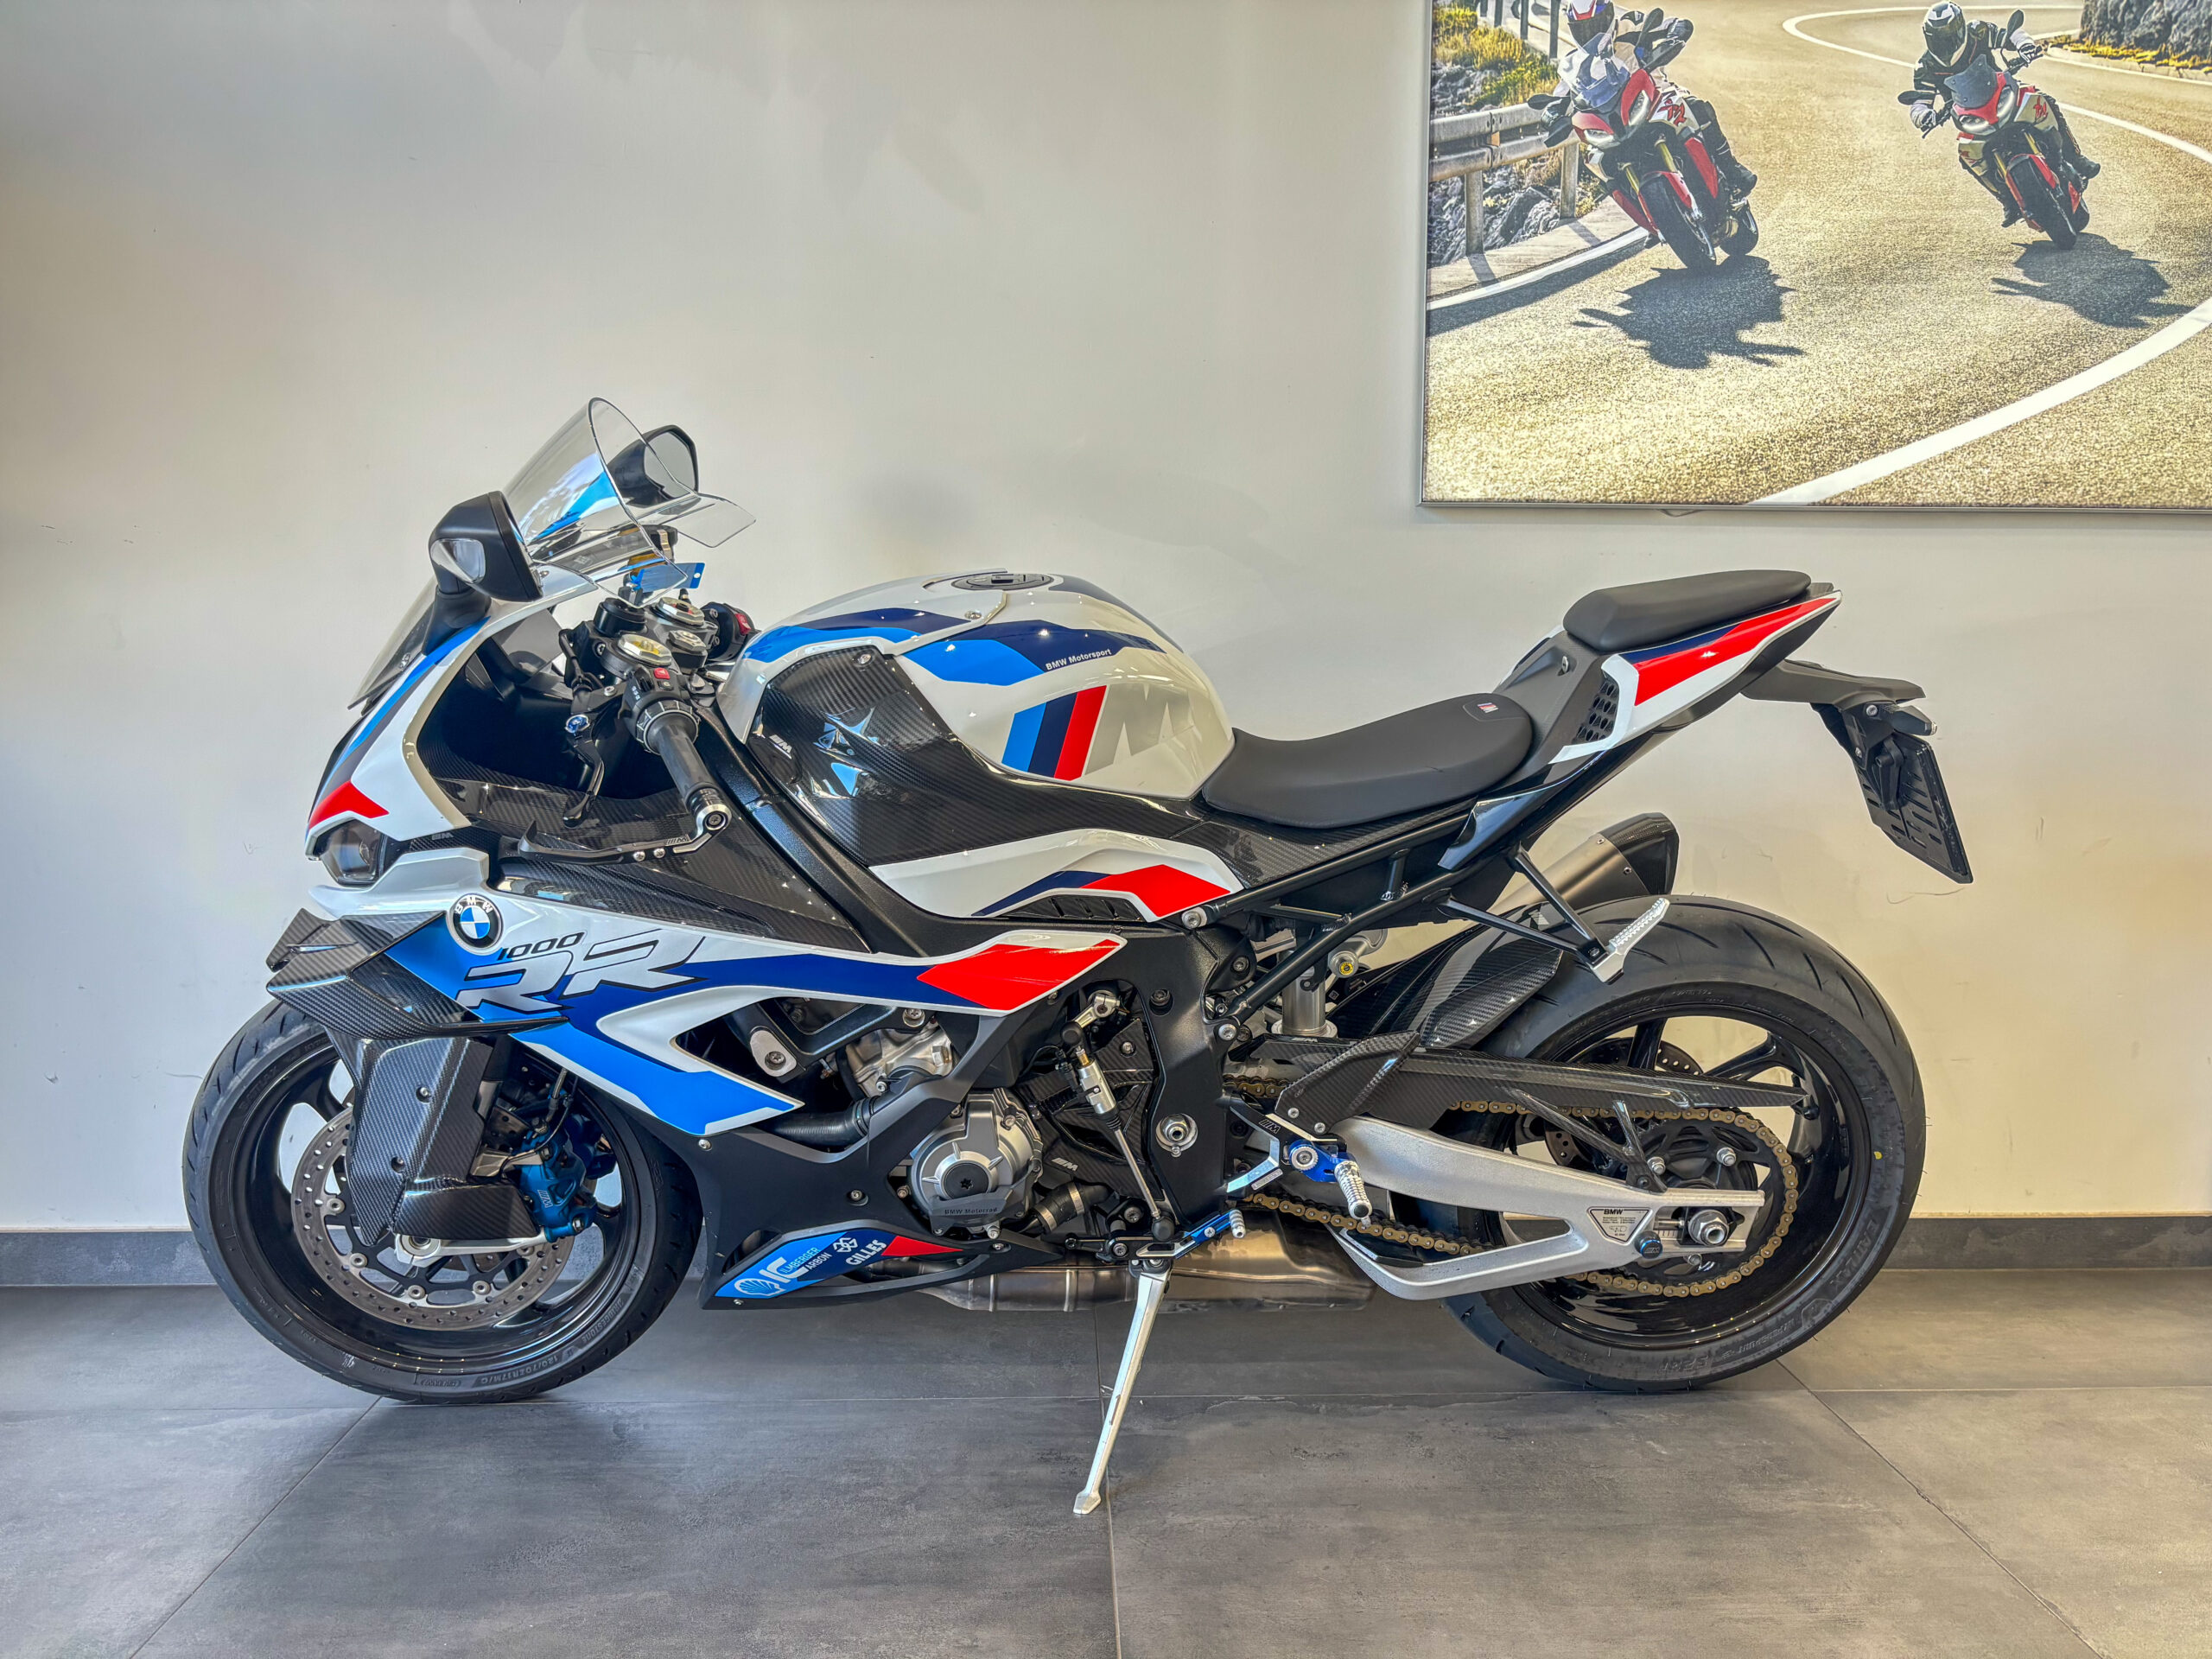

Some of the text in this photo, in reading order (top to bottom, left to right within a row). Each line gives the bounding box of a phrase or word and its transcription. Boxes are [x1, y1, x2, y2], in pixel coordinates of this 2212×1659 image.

[1046, 648, 1112, 671] BMW Motorsport
[454, 894, 492, 914] BMW
[497, 931, 585, 961] 1000
[455, 928, 709, 1014] RR
[779, 1247, 821, 1274] ILMBERGER
[845, 1239, 887, 1266] GILLES
[581, 1298, 625, 1344] BRIDGESTONE
